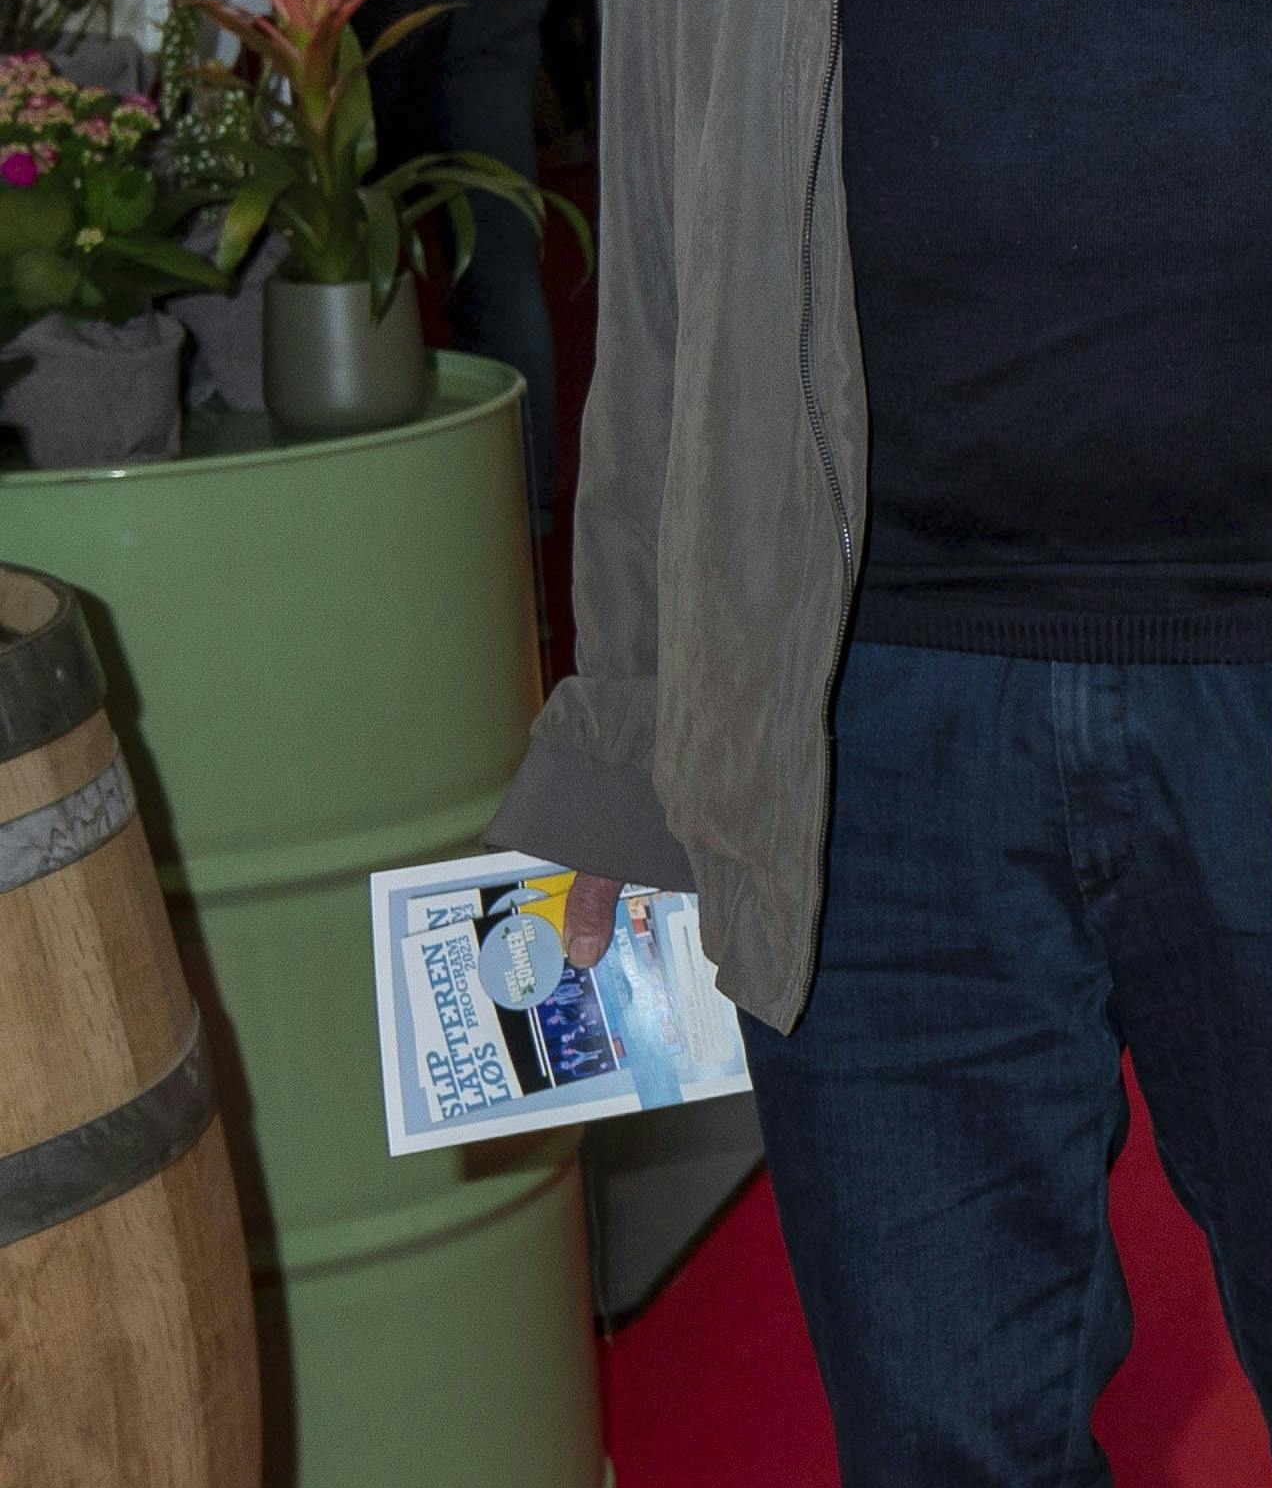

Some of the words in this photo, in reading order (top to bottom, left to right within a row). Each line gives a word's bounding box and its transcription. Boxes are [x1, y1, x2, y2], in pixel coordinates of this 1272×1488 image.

[446, 938, 479, 1030] PROGRAM
[459, 934, 477, 971] 2023
[422, 942, 489, 1113] LATTEREN
[427, 1050, 464, 1120] SLIP
[474, 1041, 513, 1105] LØS
